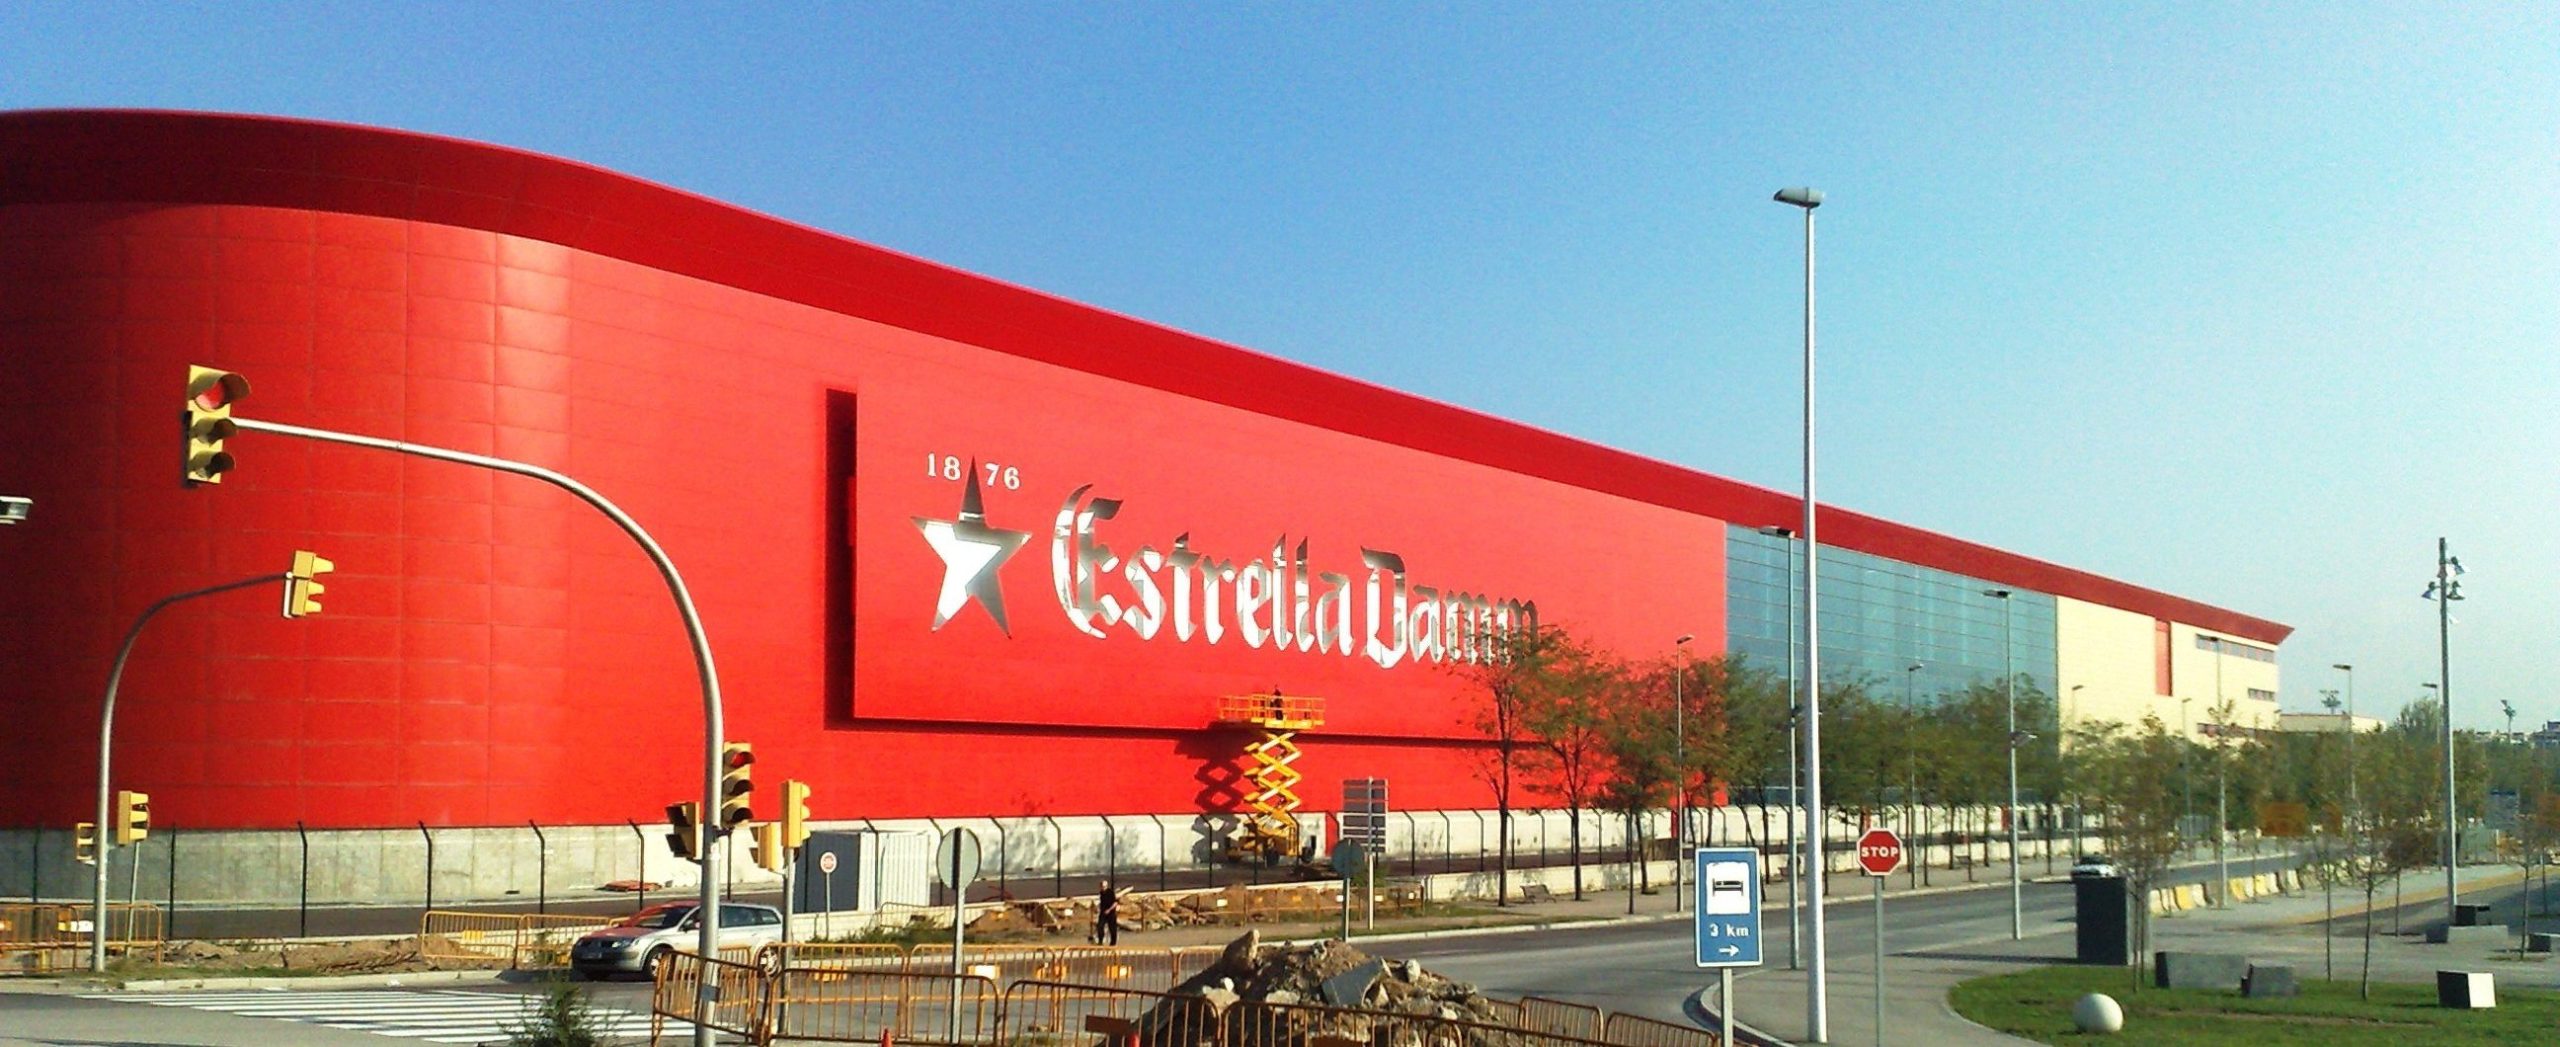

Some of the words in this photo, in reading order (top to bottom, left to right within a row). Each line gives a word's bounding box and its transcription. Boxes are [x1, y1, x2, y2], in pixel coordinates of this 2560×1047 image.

[1050, 483, 1355, 656] Estrella
[1360, 545, 1539, 669] Damm
[1860, 846, 1899, 858] STOP
[1709, 923, 1719, 937] 3
[1726, 923, 1749, 937] km
